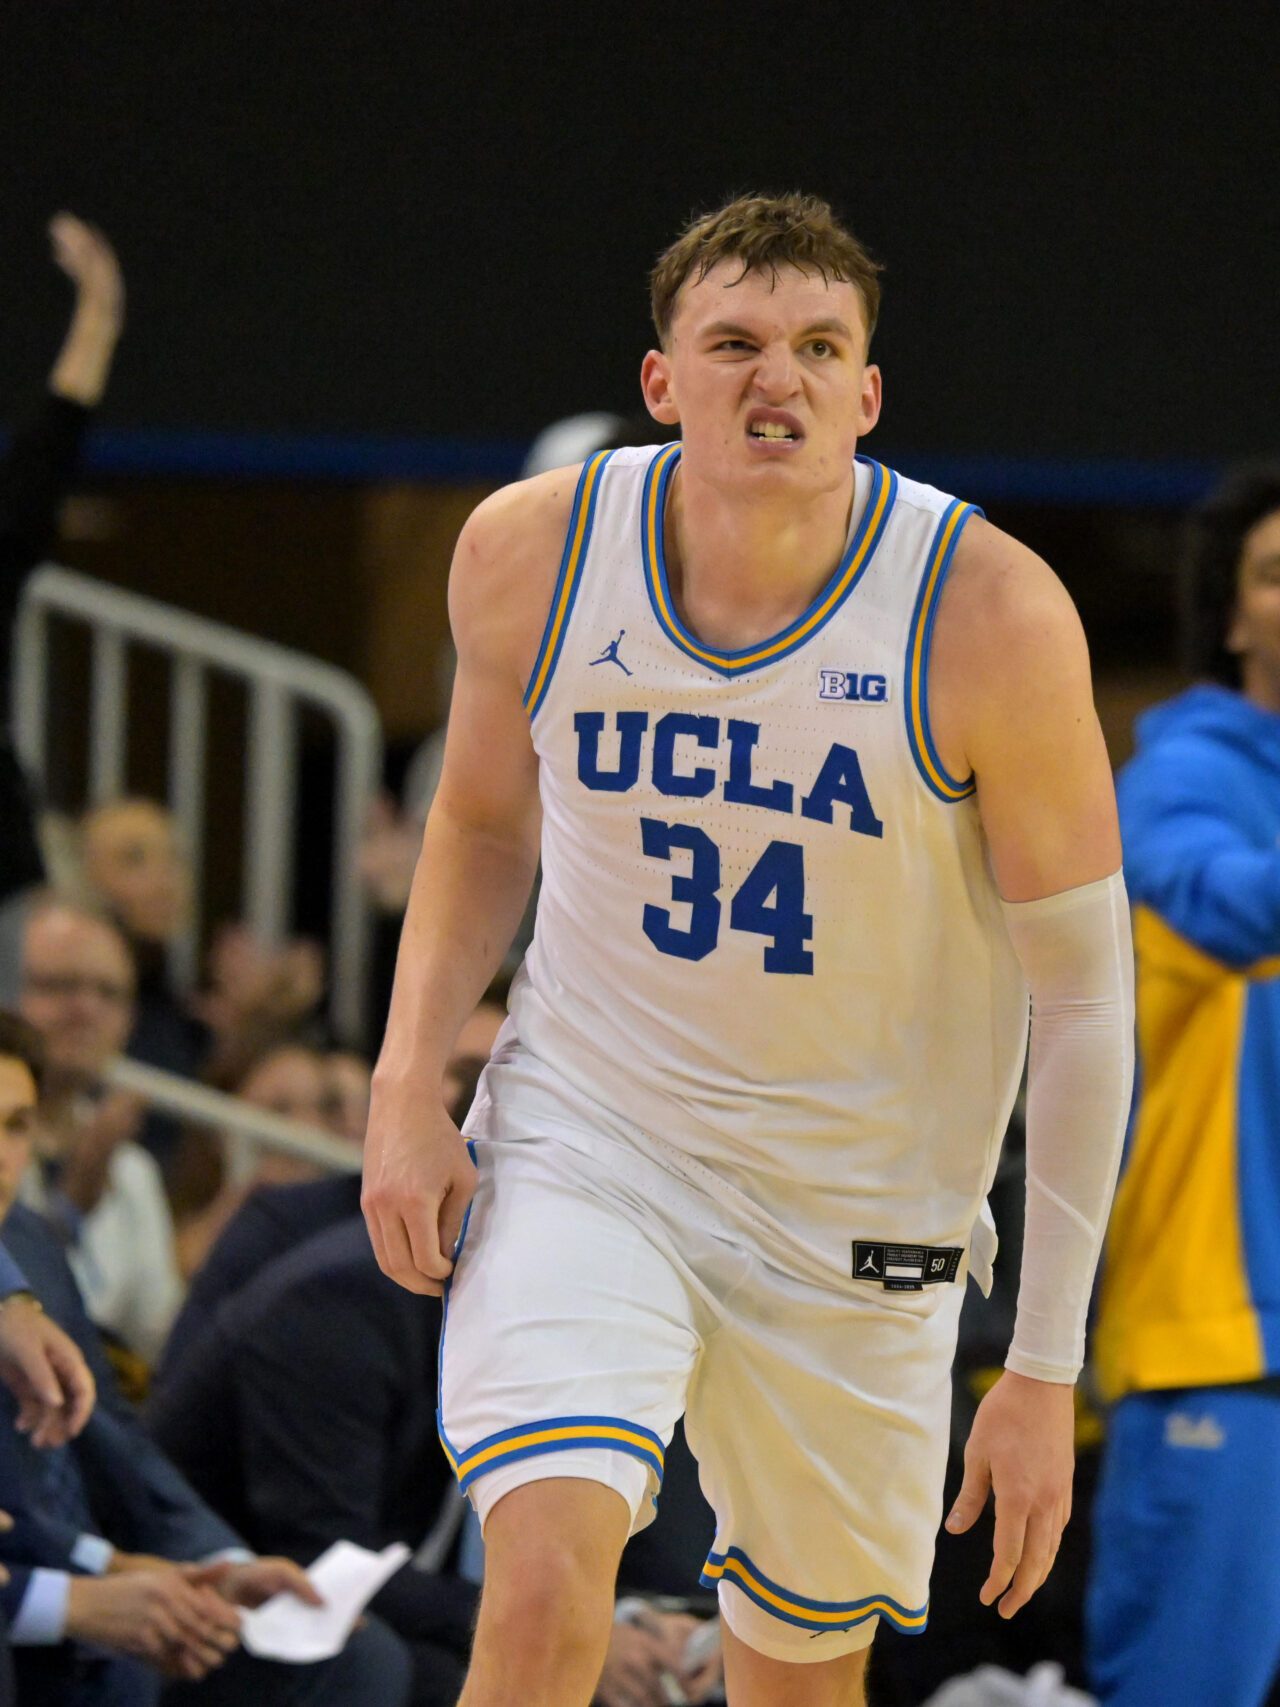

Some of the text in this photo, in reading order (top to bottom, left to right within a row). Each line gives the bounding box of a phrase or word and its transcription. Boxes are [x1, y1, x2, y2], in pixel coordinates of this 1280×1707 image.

[574, 711, 883, 838] UCLA
[640, 817, 813, 976] 34
[930, 1257, 946, 1273] 50
